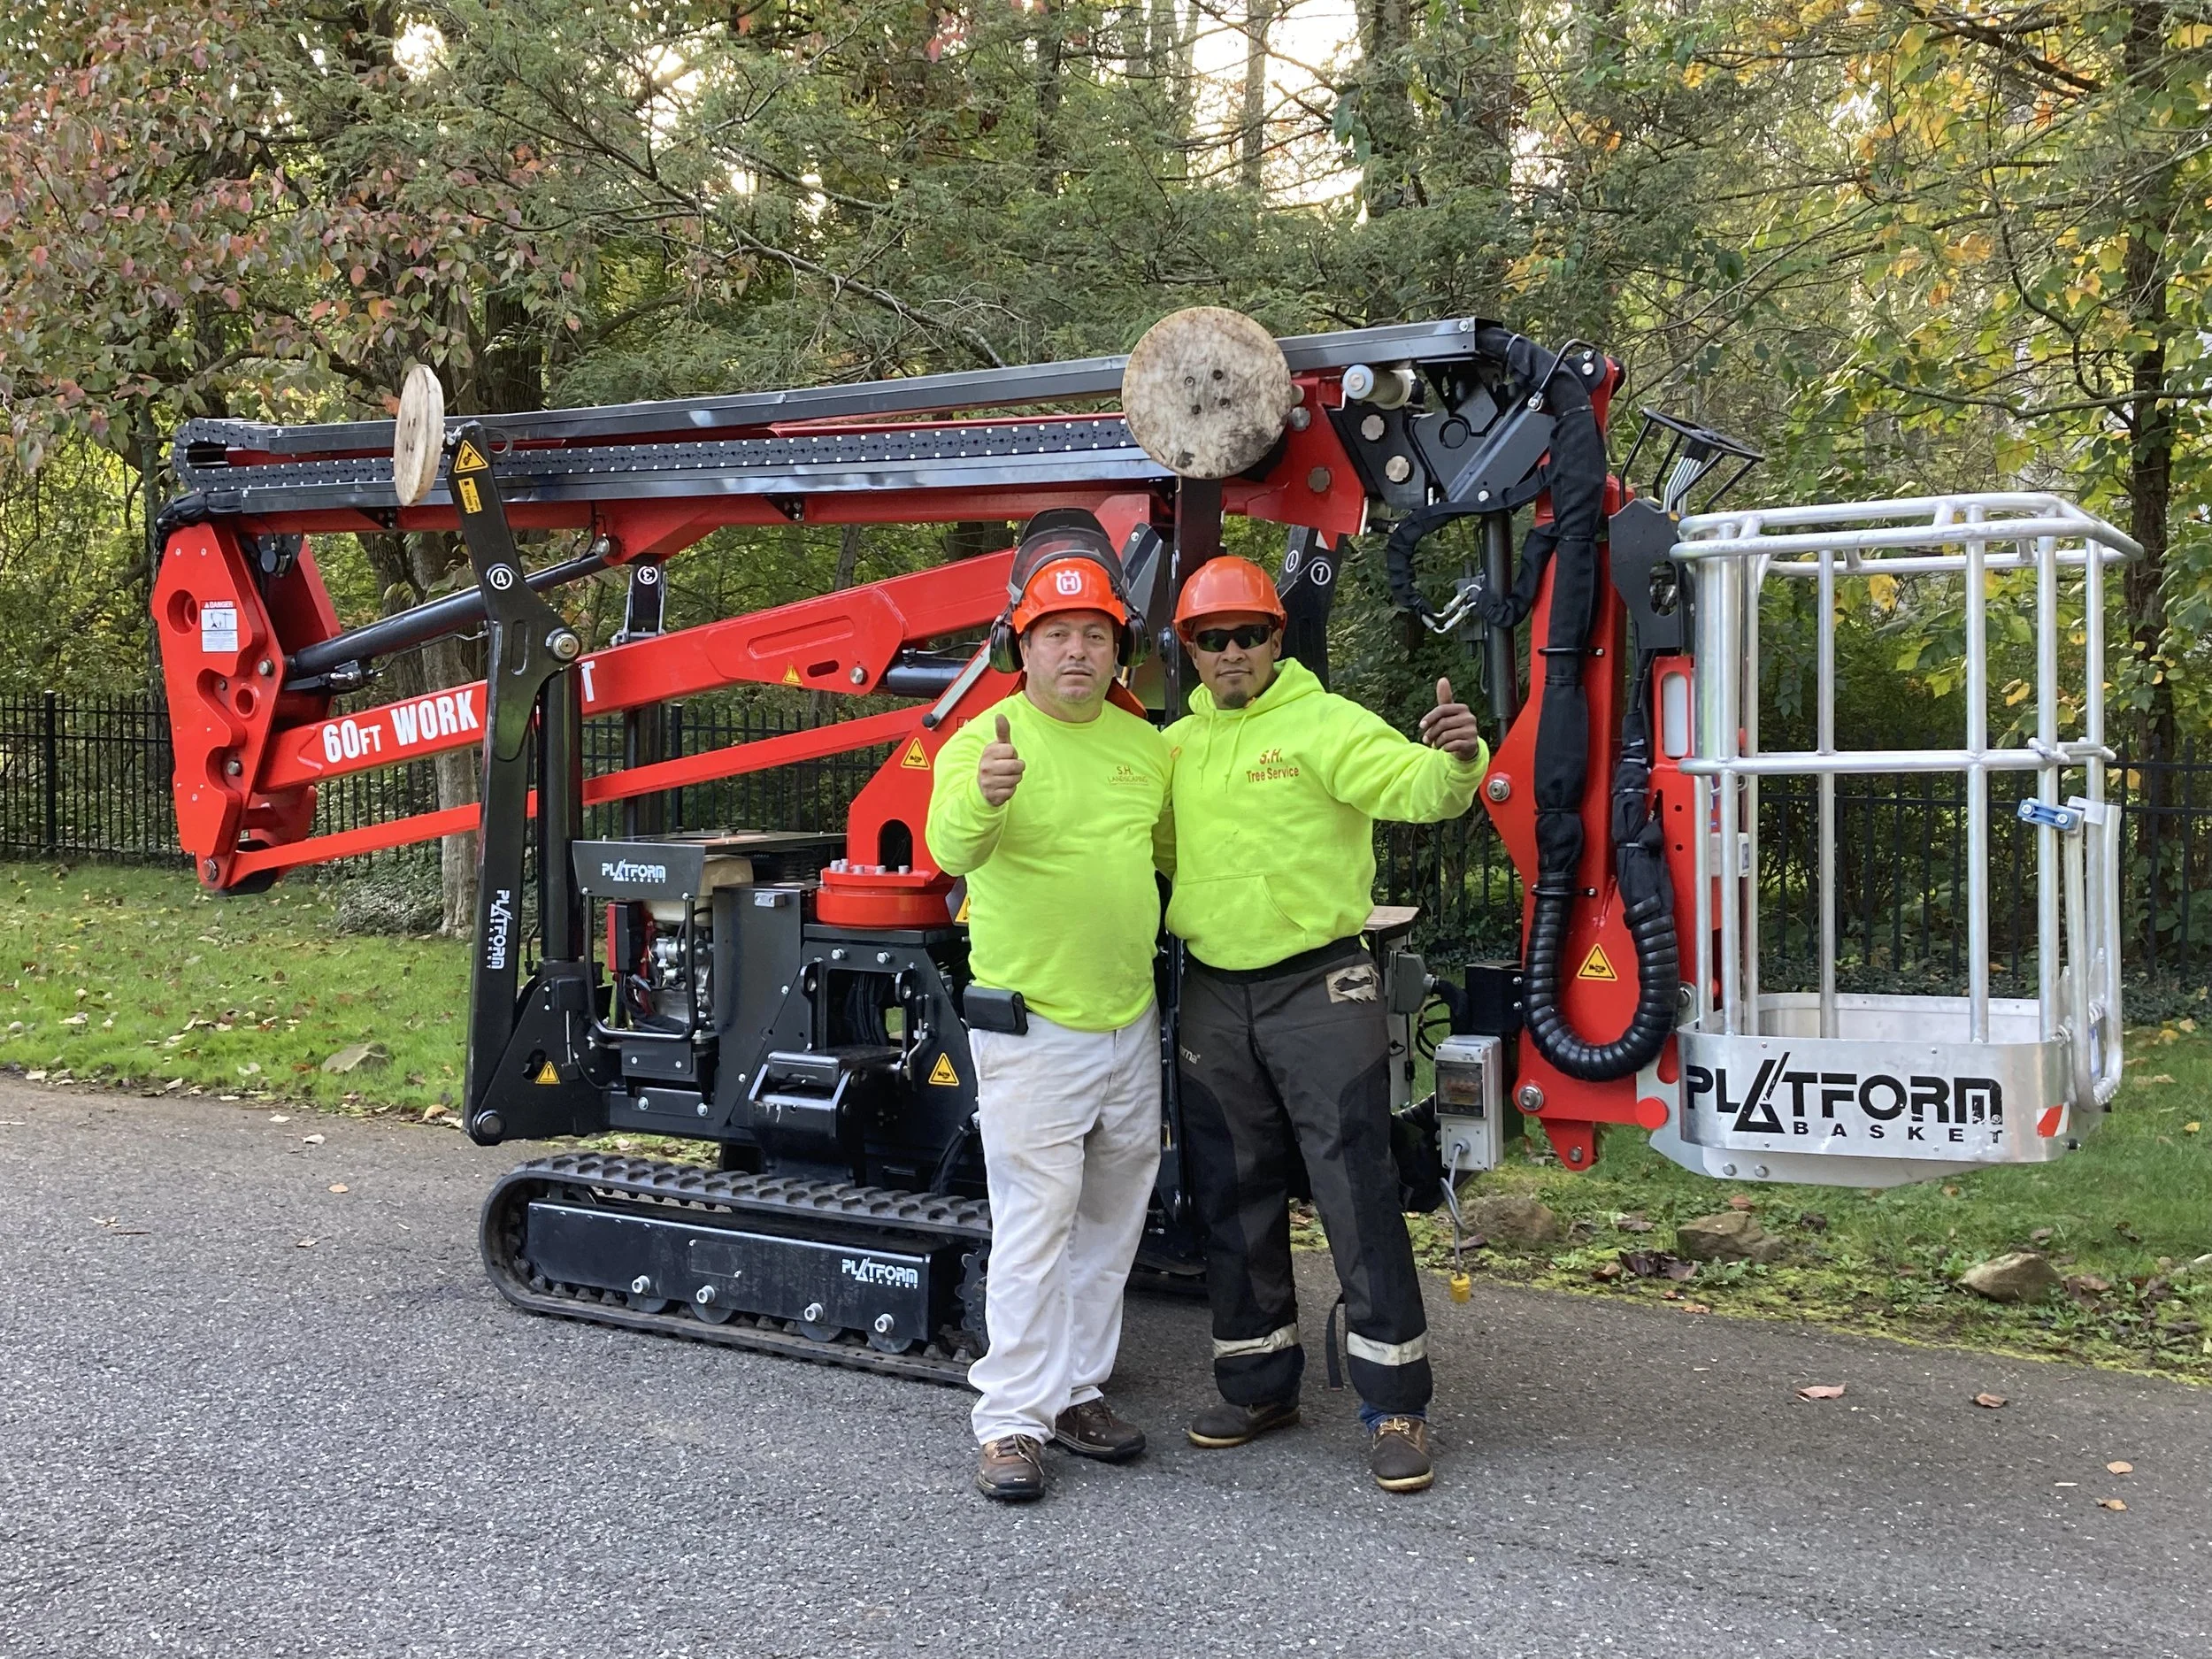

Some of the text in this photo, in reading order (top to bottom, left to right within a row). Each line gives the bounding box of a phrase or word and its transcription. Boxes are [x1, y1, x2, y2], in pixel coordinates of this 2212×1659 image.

[322, 689, 479, 764] 60FT WORK
[1246, 765, 1299, 783] Tree Service
[602, 858, 666, 881] PLATFORM
[490, 889, 513, 970] PLATFORM
[1686, 1051, 2003, 1134] PLATFORM
[1793, 1123, 2003, 1144] BASKET
[841, 1256, 918, 1284] PLATFORM
